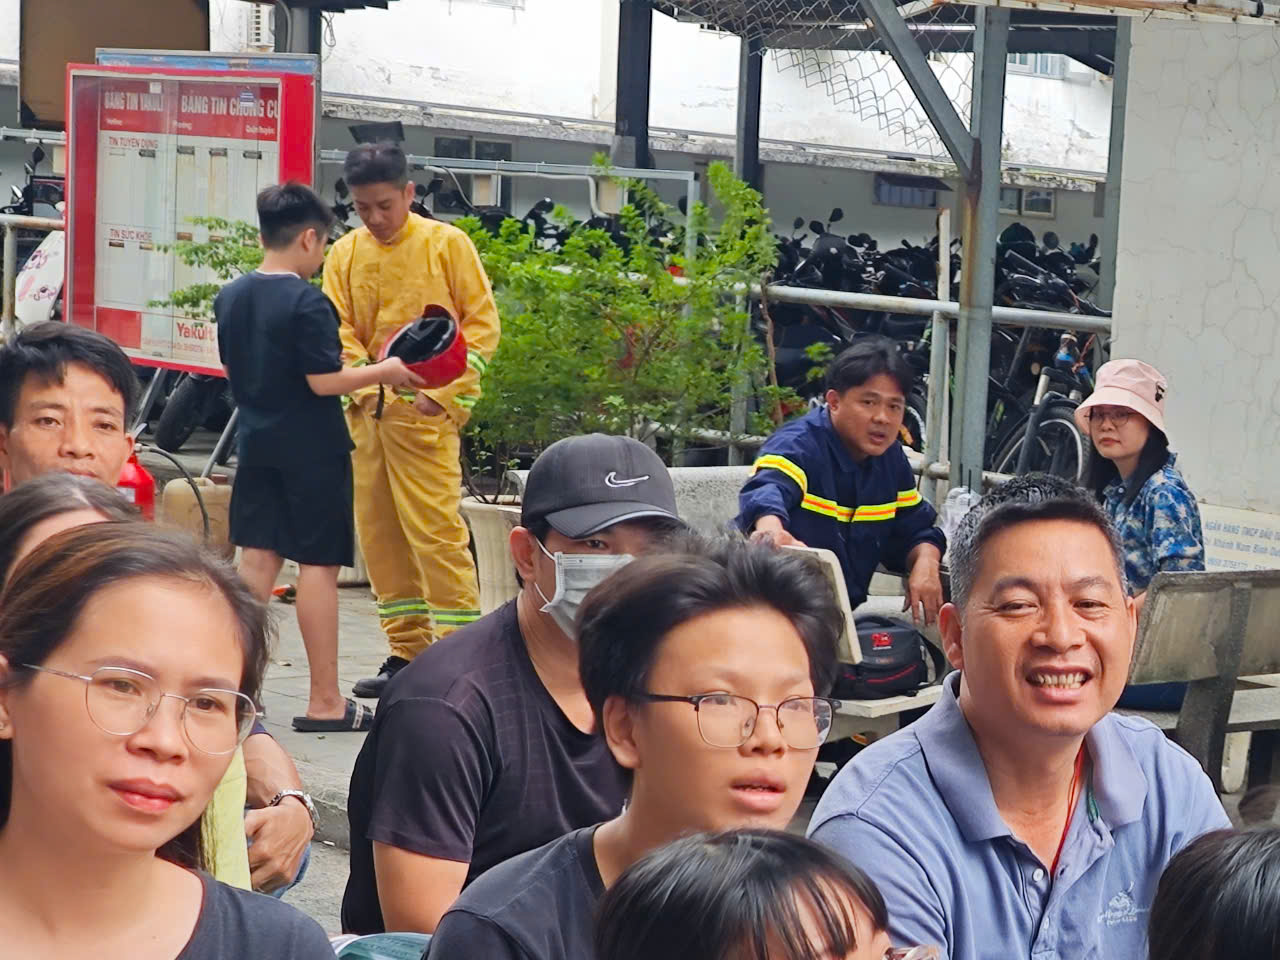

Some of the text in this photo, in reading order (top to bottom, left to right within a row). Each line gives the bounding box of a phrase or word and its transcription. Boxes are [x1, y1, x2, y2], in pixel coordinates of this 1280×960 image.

[126, 92, 138, 111] TIN
[211, 97, 228, 115] TIN
[229, 99, 264, 117] CHUNG
[176, 321, 215, 341] Yakult
